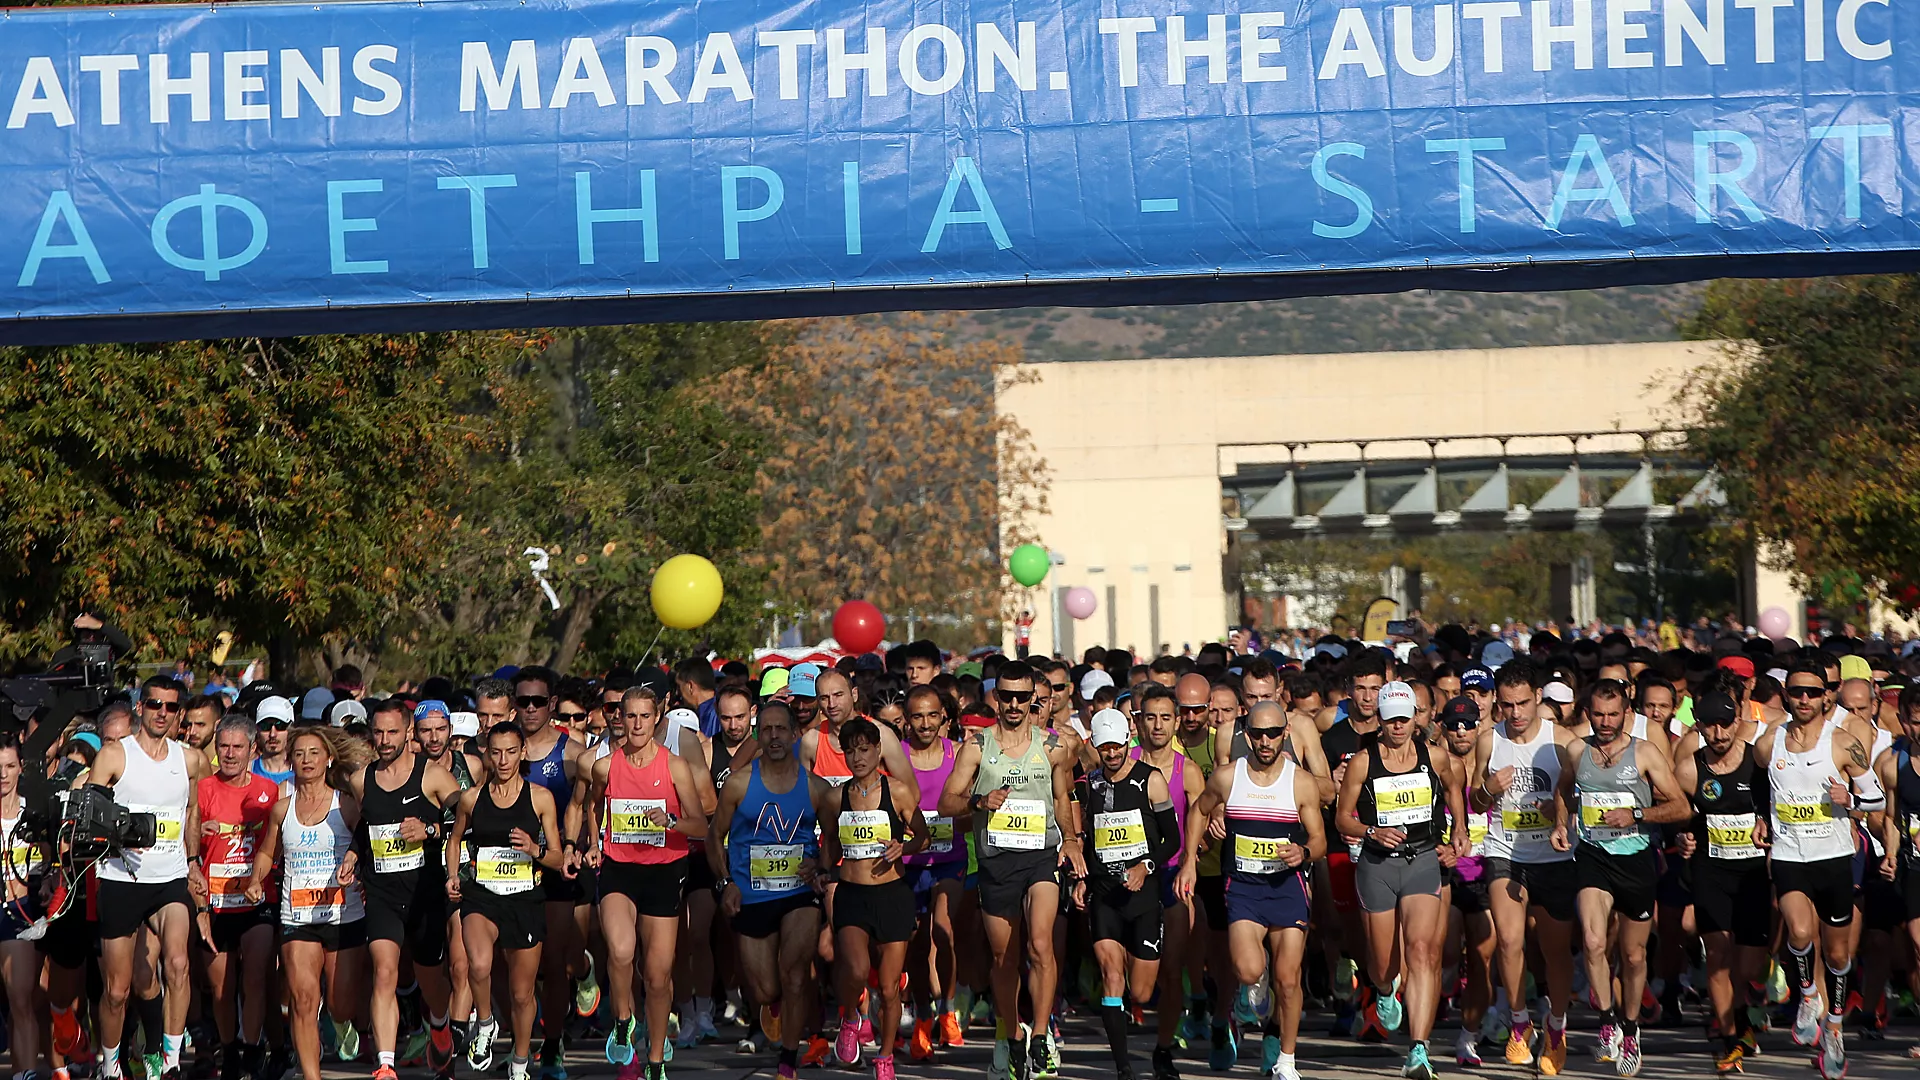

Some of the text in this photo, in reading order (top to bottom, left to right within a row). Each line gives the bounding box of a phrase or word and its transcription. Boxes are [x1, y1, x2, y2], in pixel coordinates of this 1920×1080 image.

[6, 0, 1892, 129] ATHENS MARATHON. THE AUTHENTIC
[1311, 124, 1892, 239] START
[1514, 767, 1533, 775] THE
[1002, 775, 1029, 784] PROTEIN
[1513, 776, 1534, 784] RTH
[1510, 784, 1535, 793] FACE
[1395, 791, 1416, 804] 401
[1518, 812, 1540, 825] 232
[1793, 807, 1814, 819] 209
[628, 815, 649, 828] 410
[1007, 815, 1028, 828] 201
[853, 827, 873, 840] 405
[1108, 828, 1128, 842] 202
[1725, 830, 1745, 842] 227
[226, 836, 254, 858] 25
[385, 841, 406, 853] 249
[1252, 842, 1274, 855] 215
[291, 850, 335, 859] MARATHON
[495, 863, 517, 876] 406
[767, 860, 788, 872] 319
[309, 890, 329, 902] 101
